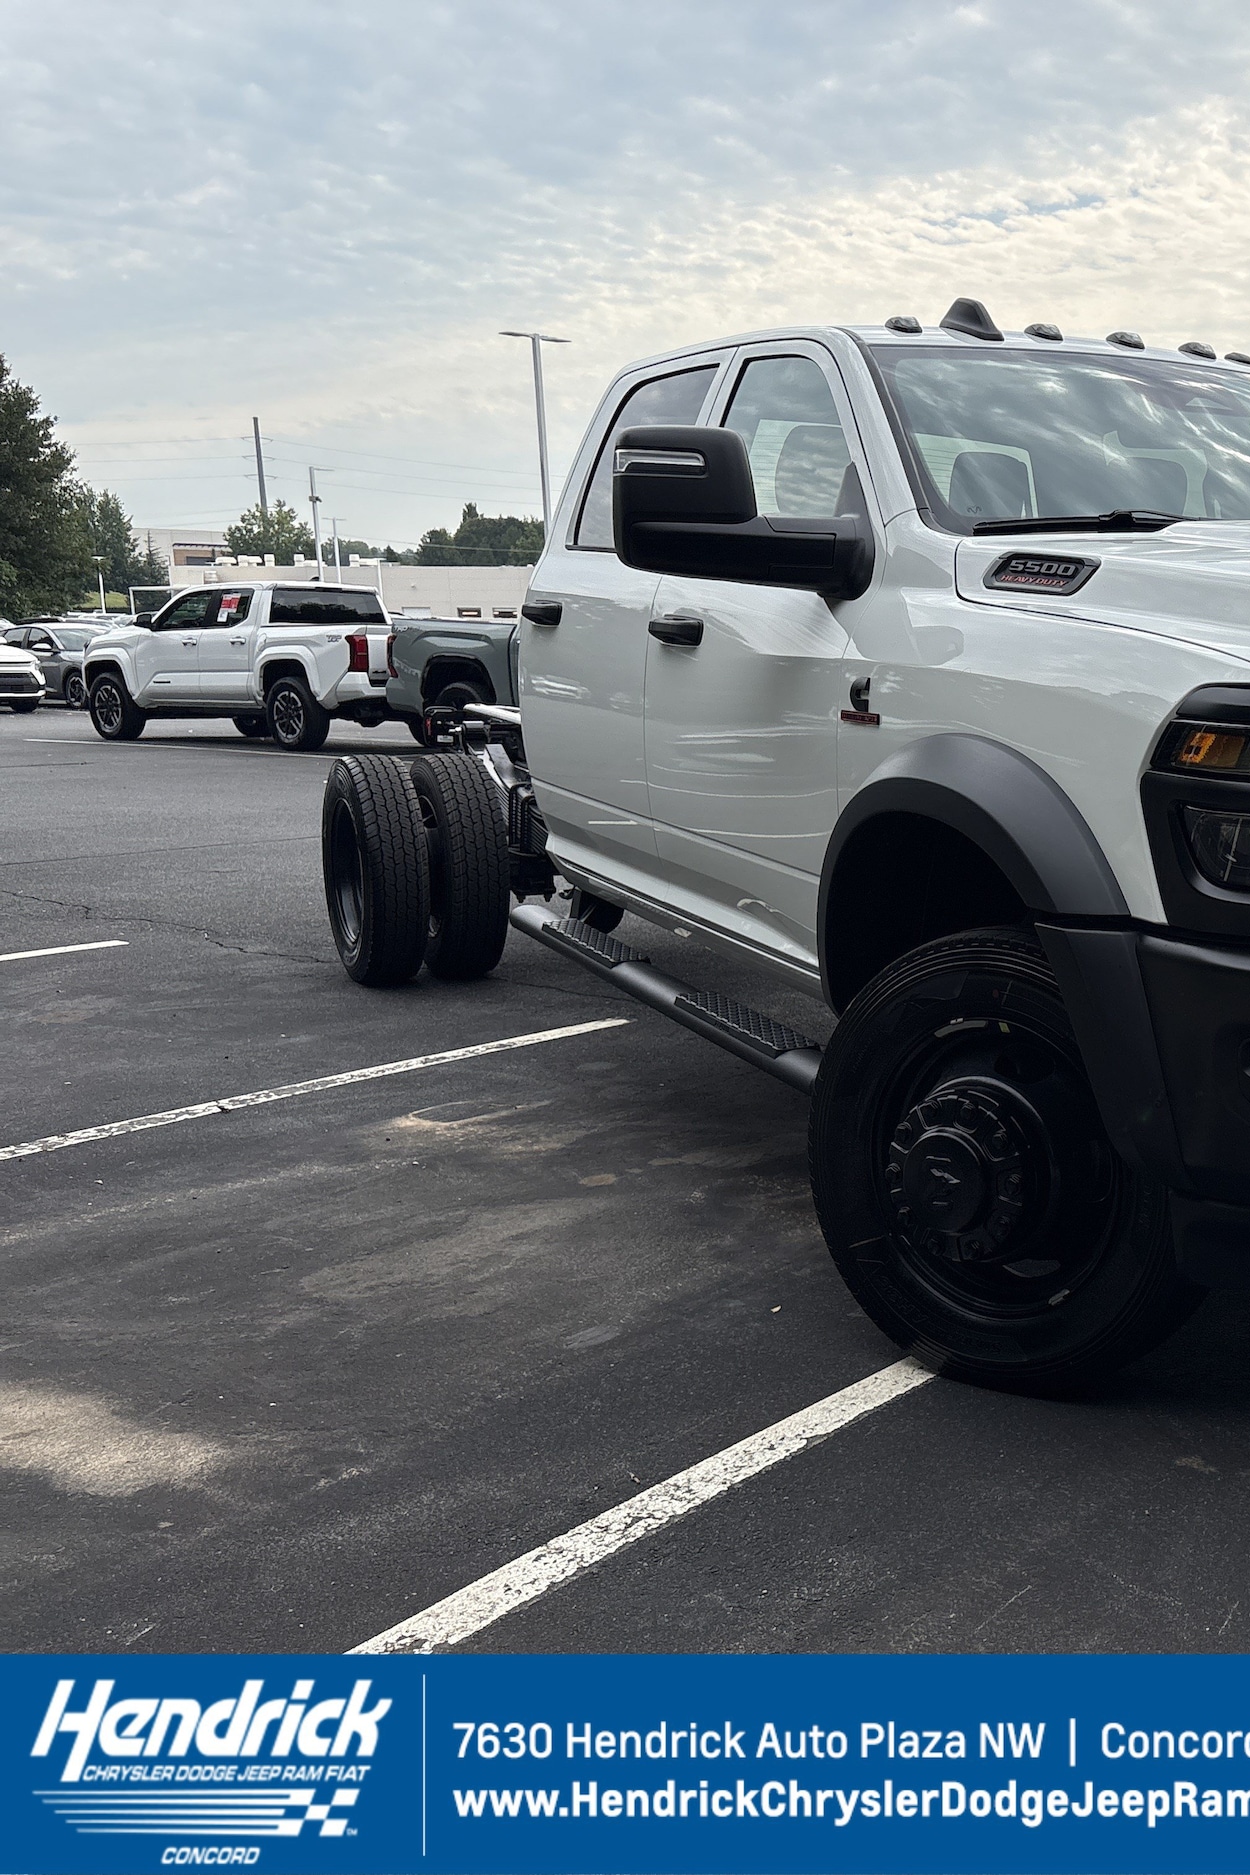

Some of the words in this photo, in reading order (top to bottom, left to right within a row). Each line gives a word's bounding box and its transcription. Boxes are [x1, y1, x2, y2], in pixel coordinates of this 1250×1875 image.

[1008, 560, 1077, 576] 5500
[1001, 574, 1036, 583] HEAVY
[1035, 578, 1067, 587] DUTY
